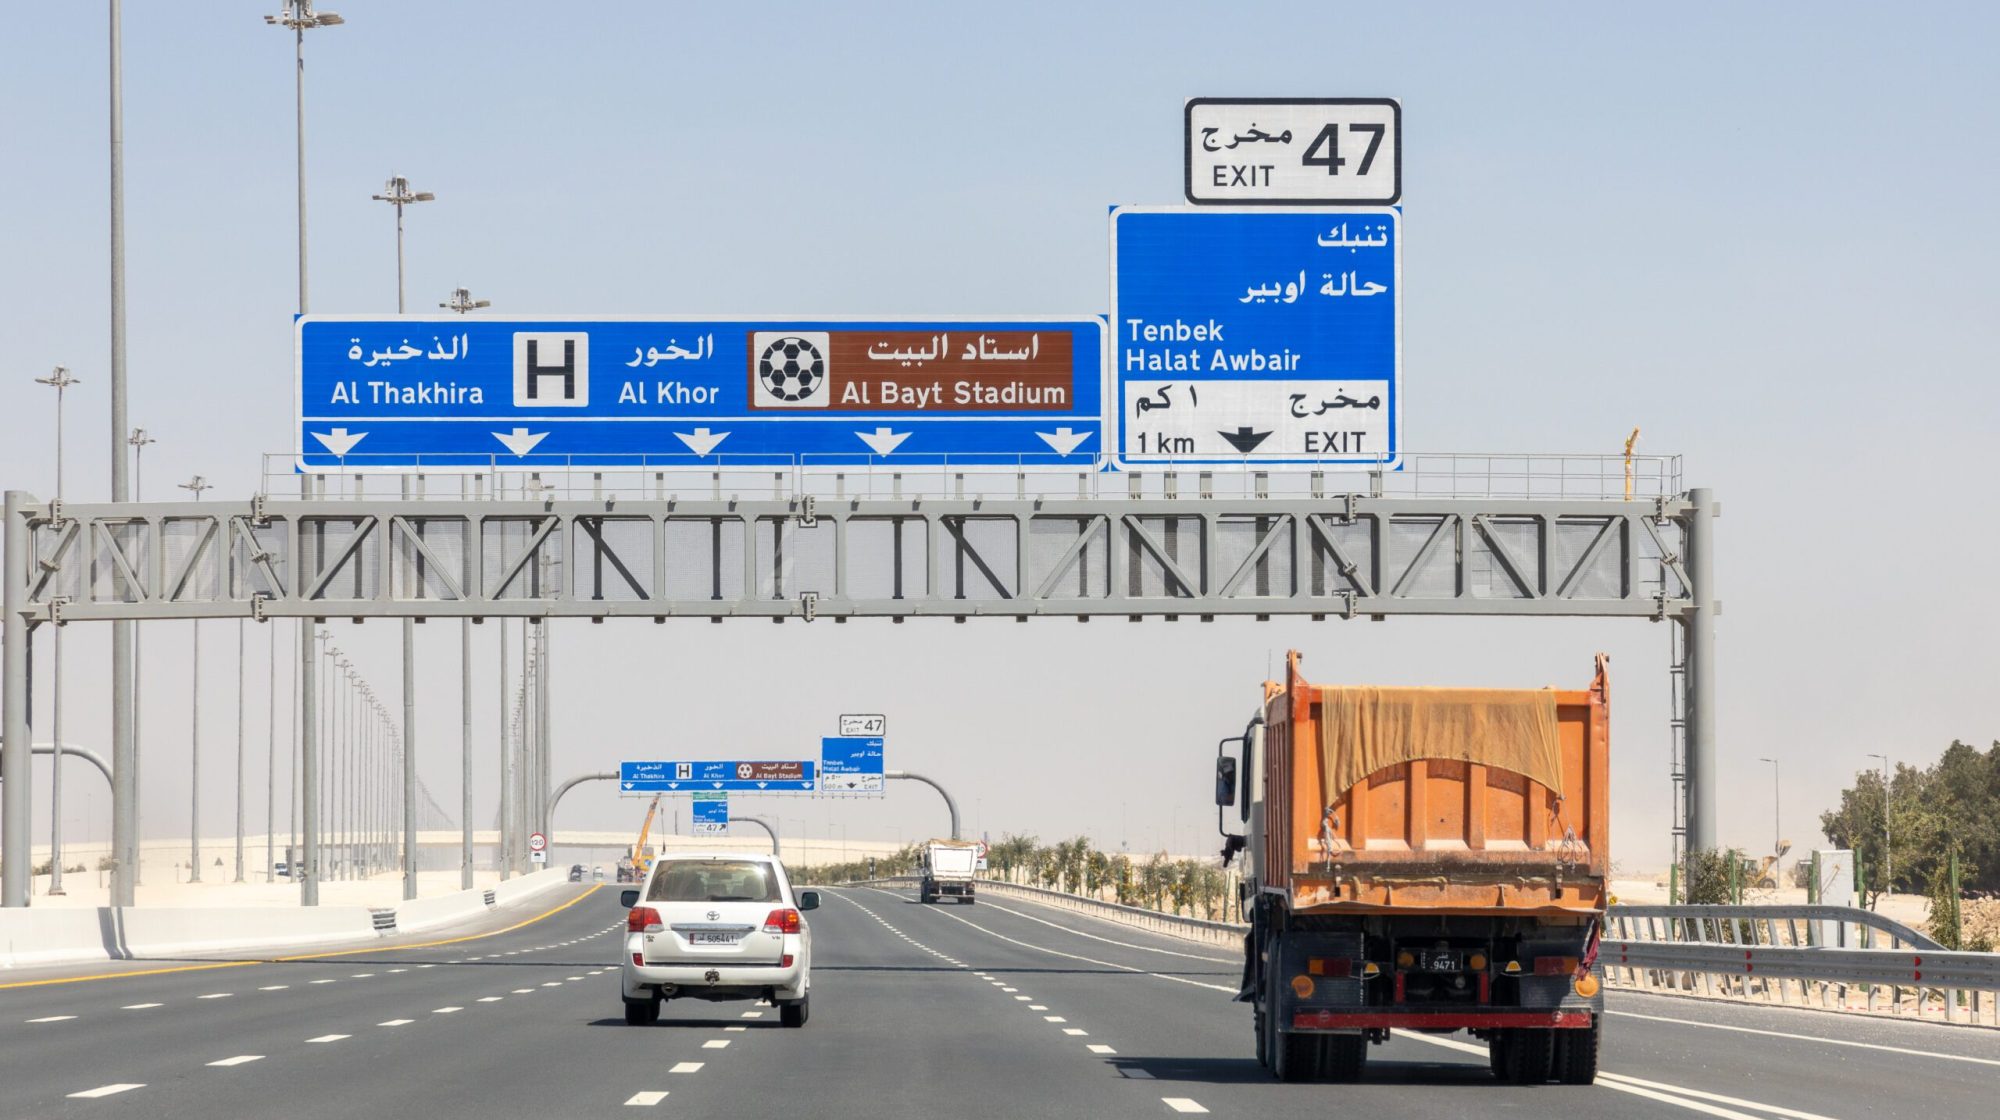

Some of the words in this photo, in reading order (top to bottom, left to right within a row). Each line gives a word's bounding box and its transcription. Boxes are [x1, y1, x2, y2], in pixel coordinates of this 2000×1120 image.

[1201, 122, 1293, 152] مخرج
[1302, 123, 1386, 176] 47
[1213, 165, 1275, 187] EXIT
[1317, 222, 1388, 254] تنبك
[1239, 269, 1306, 304] اوبير
[1319, 270, 1388, 297] حالة
[1126, 318, 1224, 342] Tenbek
[348, 333, 468, 367] الذخيرة
[626, 332, 714, 368] الخور
[867, 332, 949, 367] البيت
[961, 333, 1039, 361] استاد
[1126, 348, 1201, 371] Halat
[1210, 348, 1301, 371] Awbair
[526, 339, 575, 400] H
[331, 381, 360, 404] Al
[367, 381, 484, 404] Thakhira
[618, 381, 647, 404] Al
[657, 381, 720, 404] Khor
[840, 381, 871, 404] Al
[881, 381, 943, 409] Bayt
[953, 380, 1066, 405] Stadium
[1136, 384, 1173, 419] كم
[1289, 387, 1381, 418] مخرج
[1137, 431, 1146, 453] 1
[1157, 431, 1195, 453] km
[1304, 431, 1367, 453] EXIT
[864, 719, 882, 731] 47
[678, 764, 690, 778] H
[1433, 960, 1455, 970] 9471
